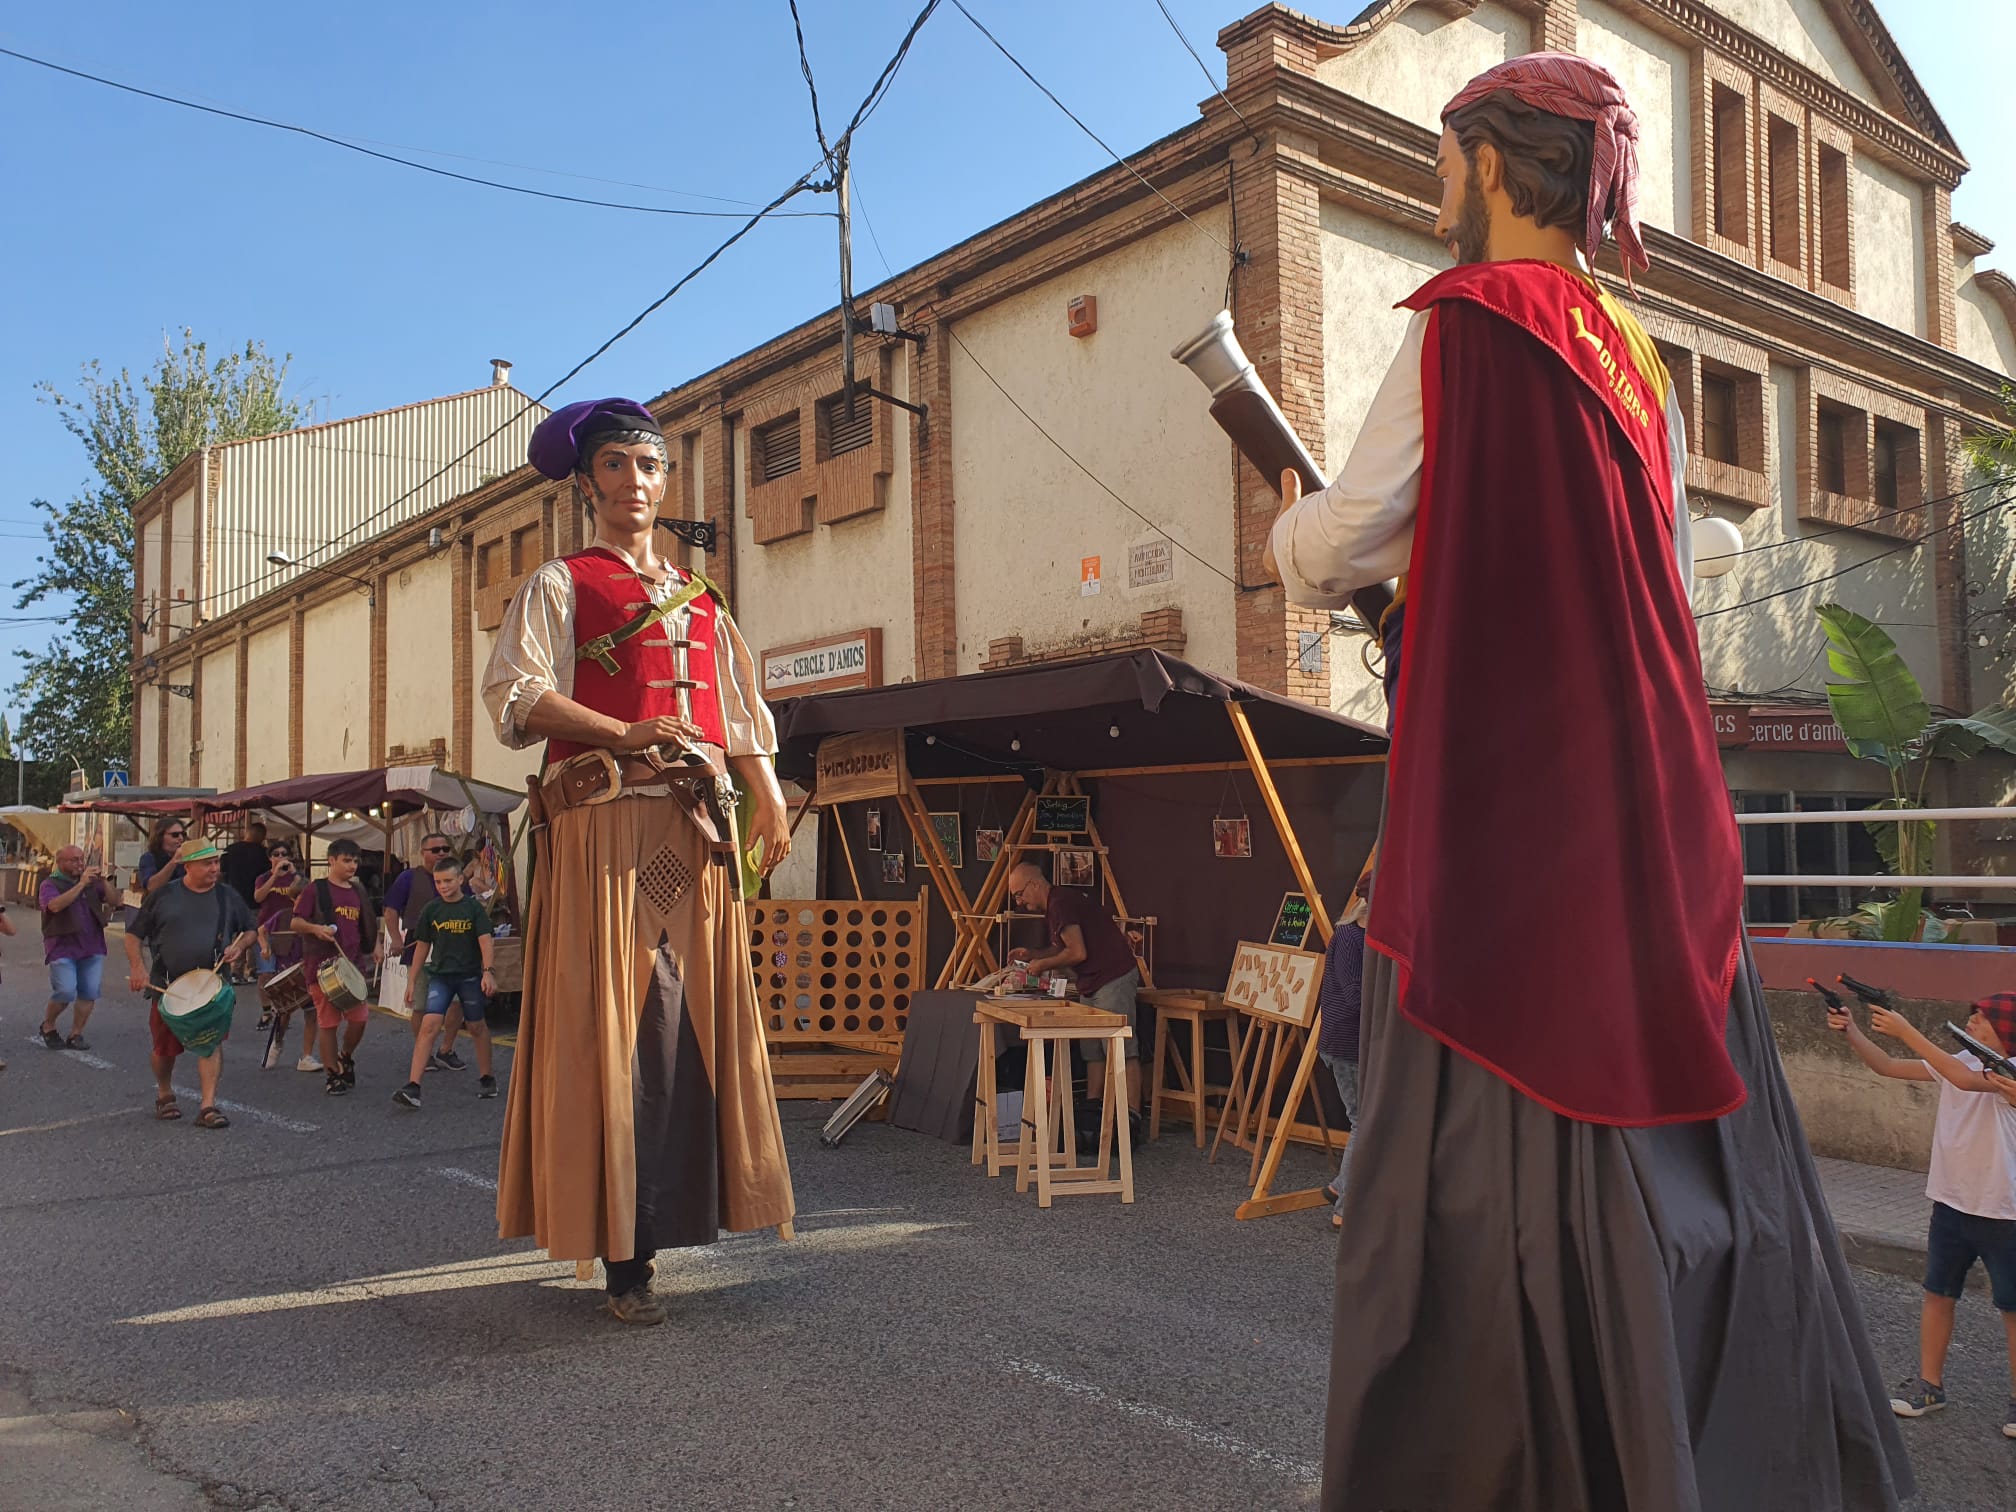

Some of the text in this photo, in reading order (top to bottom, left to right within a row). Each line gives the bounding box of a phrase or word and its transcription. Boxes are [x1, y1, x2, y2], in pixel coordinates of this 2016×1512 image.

[1568, 306, 1649, 429] VOLTORS
[793, 645, 865, 678] CERCLE D'AMICS
[1748, 723, 1793, 742] cercle
